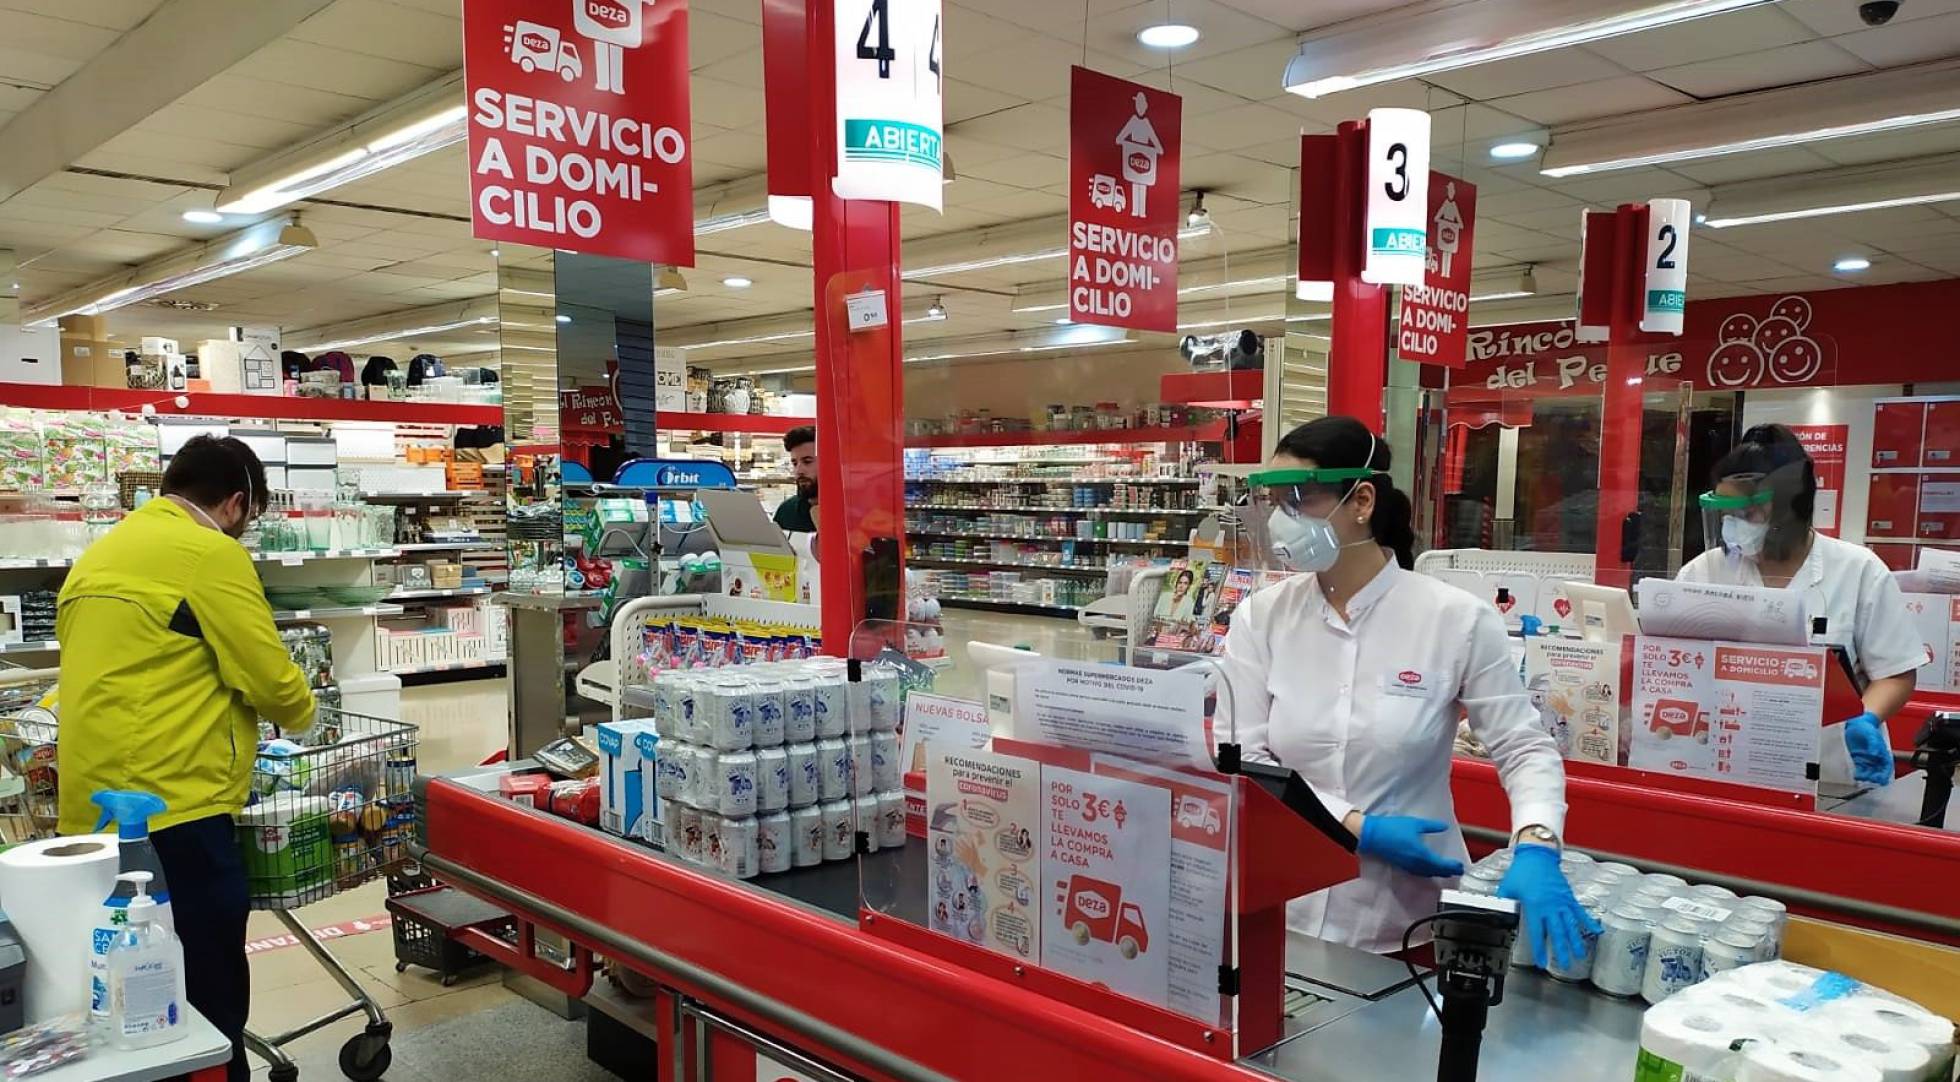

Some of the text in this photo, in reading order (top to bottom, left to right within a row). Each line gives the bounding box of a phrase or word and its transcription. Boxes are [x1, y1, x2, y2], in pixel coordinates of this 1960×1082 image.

[856, 0, 896, 79] 4
[474, 87, 685, 164] SERVICIO
[865, 125, 941, 158] ABIERT
[476, 137, 658, 201] A DOMI-
[1384, 142, 1410, 201] 3
[479, 185, 602, 239] CILIO
[1073, 221, 1175, 264] SERVICIO
[1656, 224, 1677, 269] 2
[1073, 255, 1160, 290] A DOMI-
[1073, 286, 1131, 318] CILIO
[1404, 285, 1467, 312] SERVICIO
[1402, 306, 1457, 334] A DOMI-
[1401, 331, 1438, 356] CILIO
[1486, 361, 1538, 390] del
[1641, 669, 1689, 680] LLEVAMOS
[1720, 654, 1780, 668] SERVICIO
[1729, 666, 1779, 676] DOMICILIO
[1654, 679, 1693, 689] COMPRA
[915, 702, 954, 718] NUEVAS
[1051, 781, 1110, 822] POR 3€
[1051, 796, 1080, 810] SOLO
[1052, 808, 1064, 820] TE
[1051, 823, 1109, 845] LLEVAMOS
[1051, 836, 1114, 861] LA COMPRA
[1051, 851, 1090, 868] A CASA
